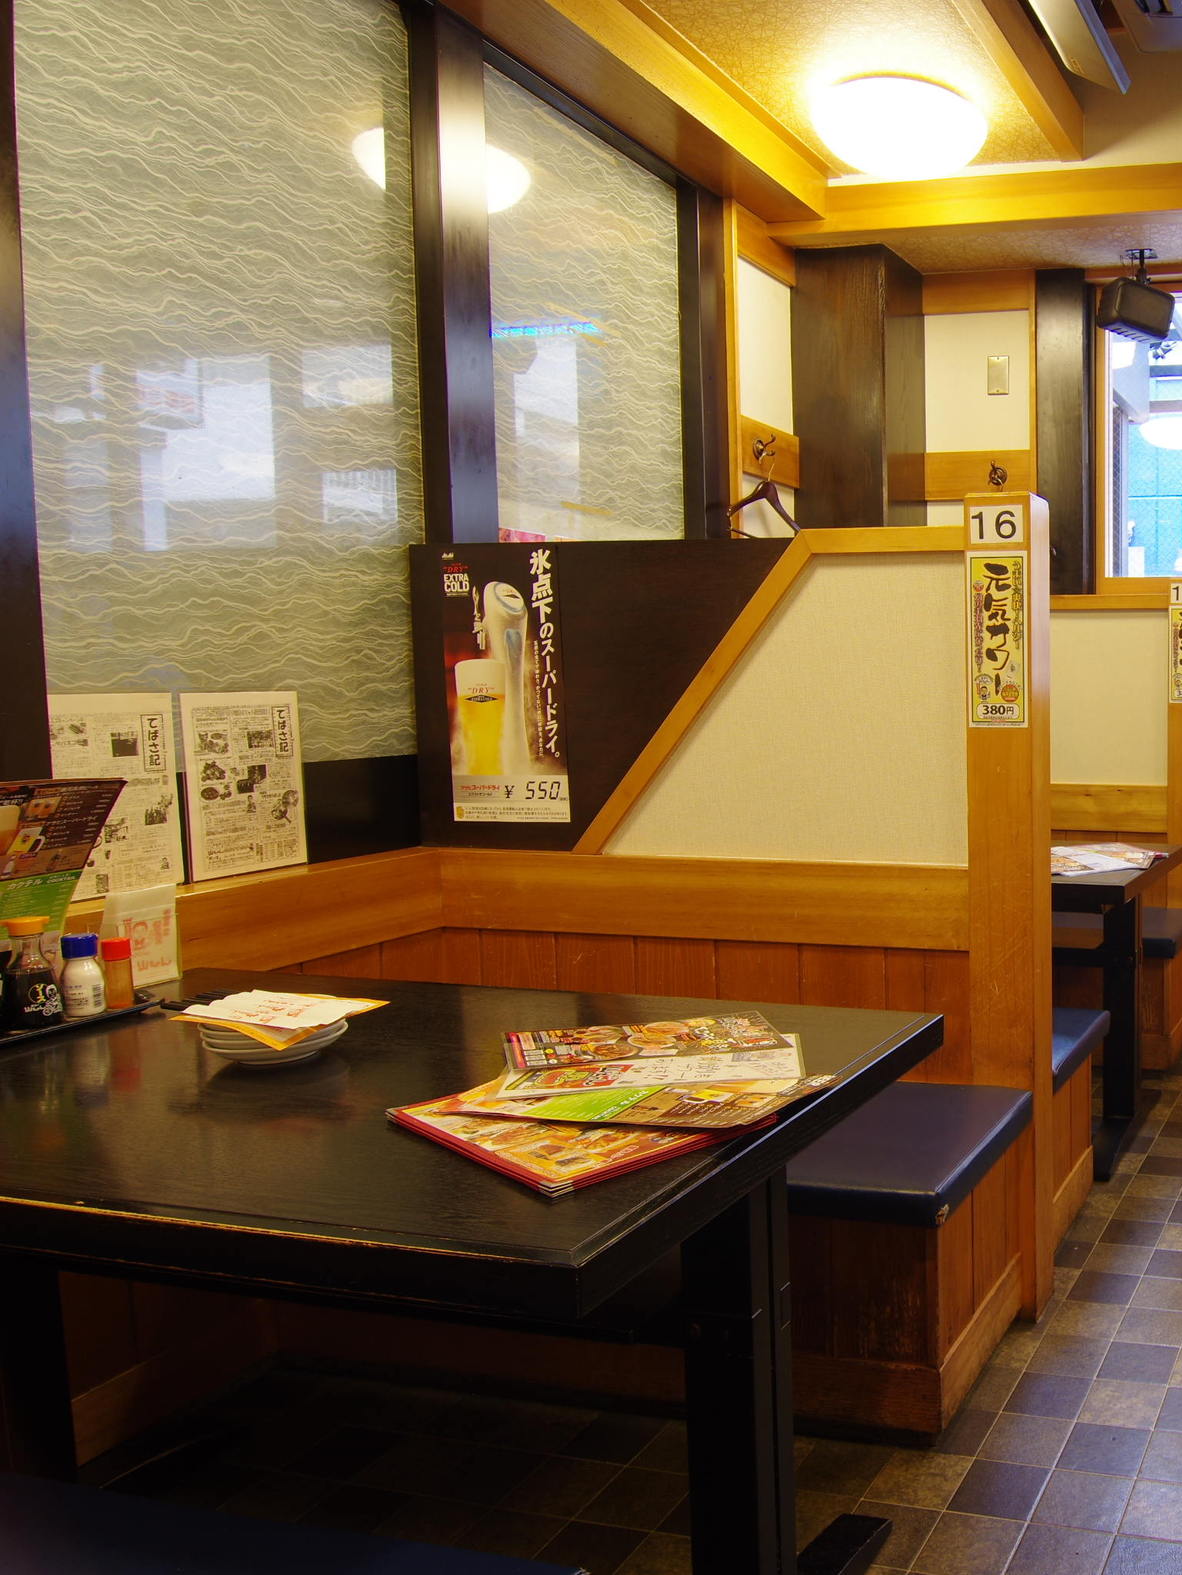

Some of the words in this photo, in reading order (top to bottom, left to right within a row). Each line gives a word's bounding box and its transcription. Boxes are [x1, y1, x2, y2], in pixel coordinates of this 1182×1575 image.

[971, 510, 1017, 540] 16
[443, 574, 470, 582] EXTRA
[444, 581, 470, 592] COLD
[529, 548, 560, 758] 氷点下のスーパードライ。
[982, 705, 1015, 715] 380円
[147, 717, 161, 766] てばさ記
[276, 709, 289, 753] てばさ記
[525, 781, 561, 800] 550
